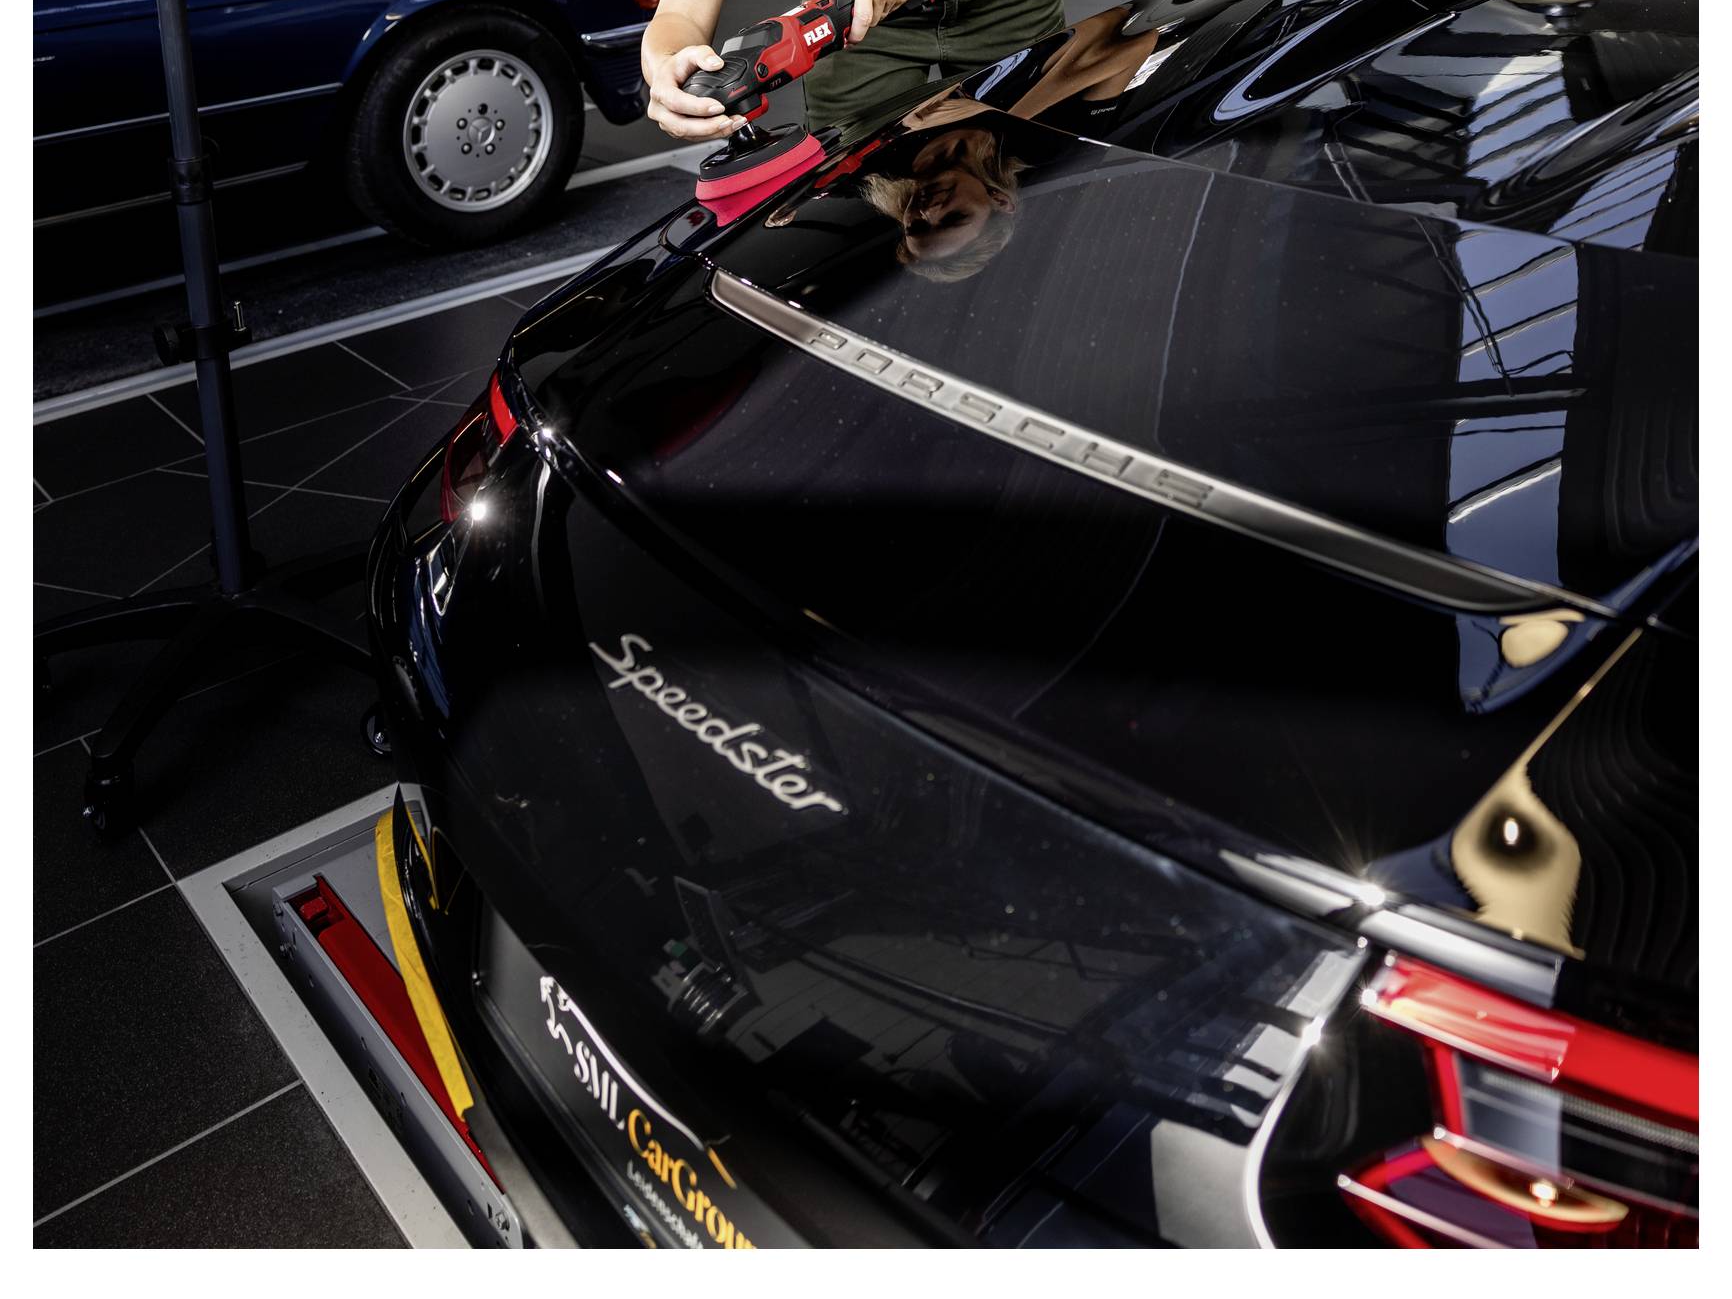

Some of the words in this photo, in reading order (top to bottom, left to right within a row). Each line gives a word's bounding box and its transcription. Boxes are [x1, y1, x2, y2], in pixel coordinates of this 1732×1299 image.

[803, 21, 832, 47] FLEX
[807, 327, 1215, 509] PORSCHE
[588, 633, 843, 812] Speedster
